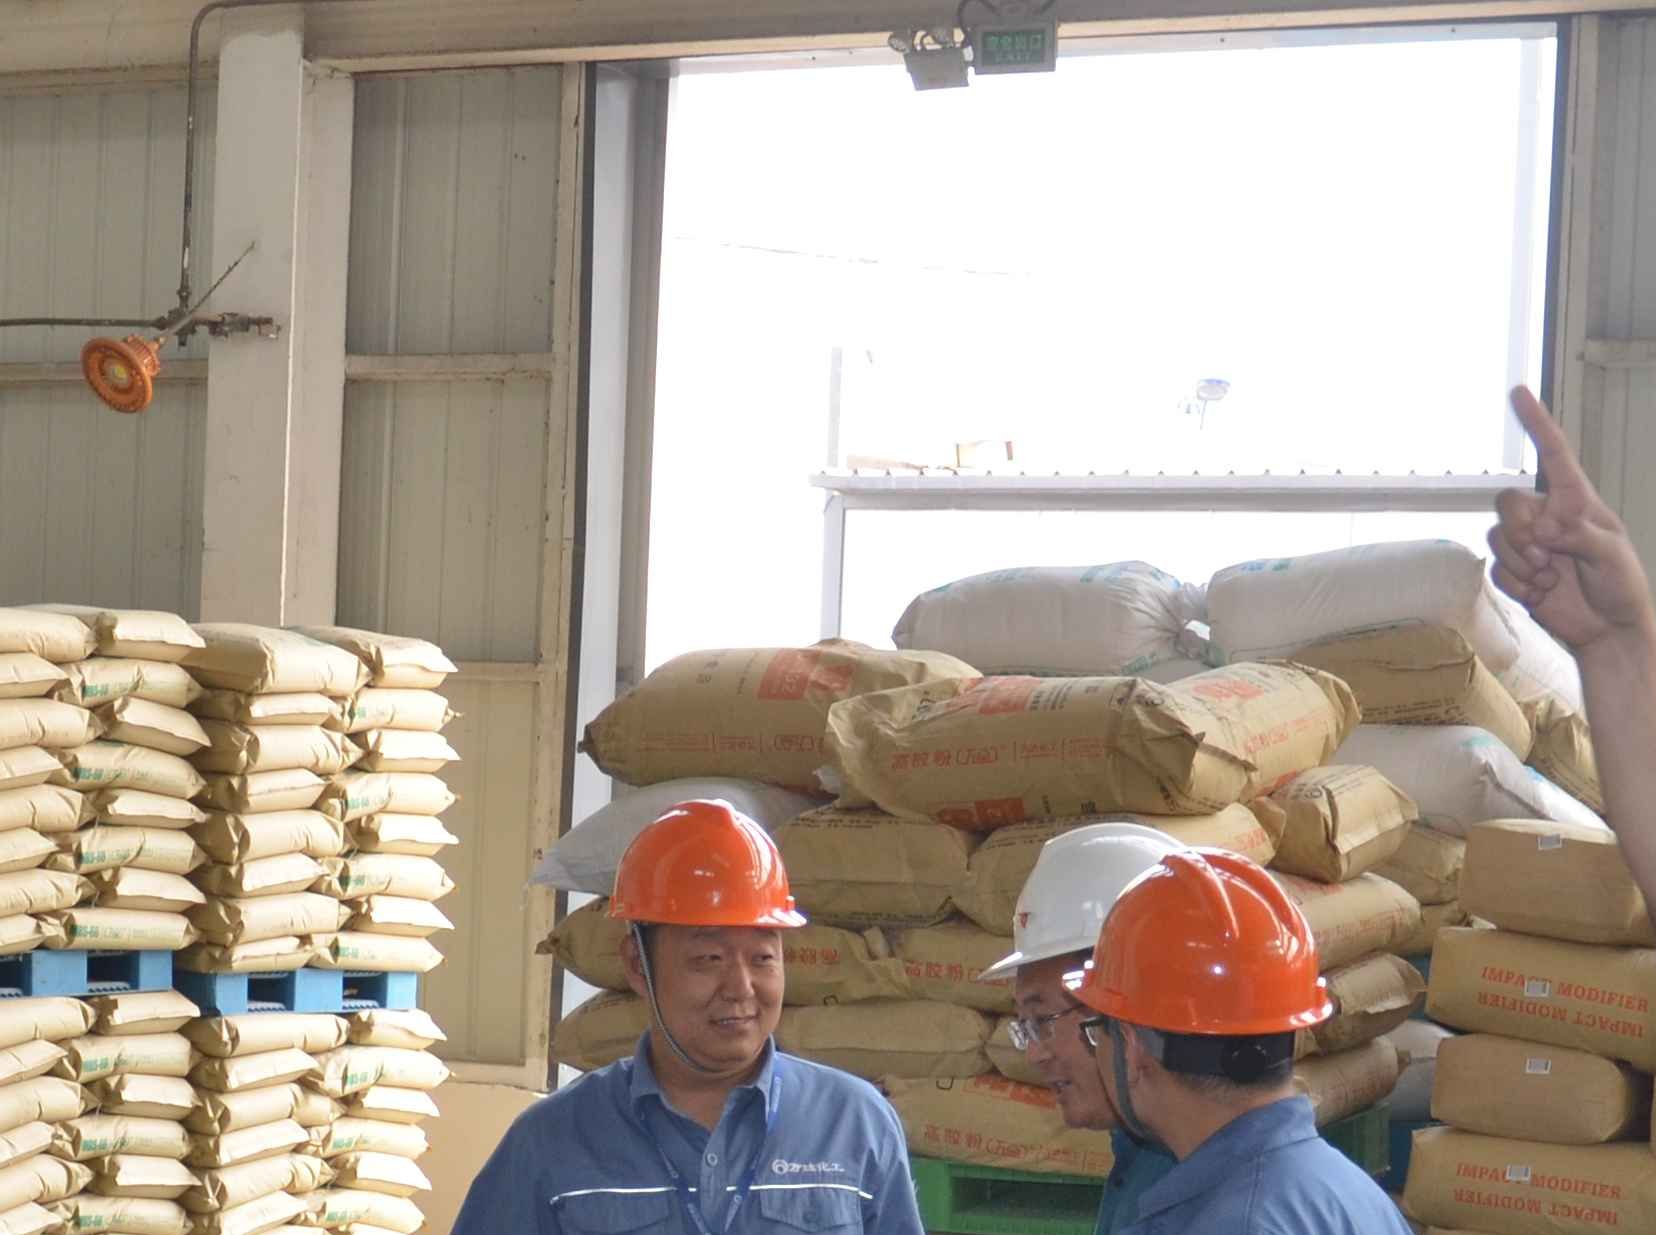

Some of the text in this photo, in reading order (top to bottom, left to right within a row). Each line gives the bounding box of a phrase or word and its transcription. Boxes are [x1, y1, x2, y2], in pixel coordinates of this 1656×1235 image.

[1481, 966, 1649, 1012] IMPA MODIFIER
[1478, 992, 1643, 1038] IMPACT MODIFIER
[1454, 1189, 1617, 1225] IMPACT MODIFIER
[1531, 1174, 1621, 1199] MODIFIER
